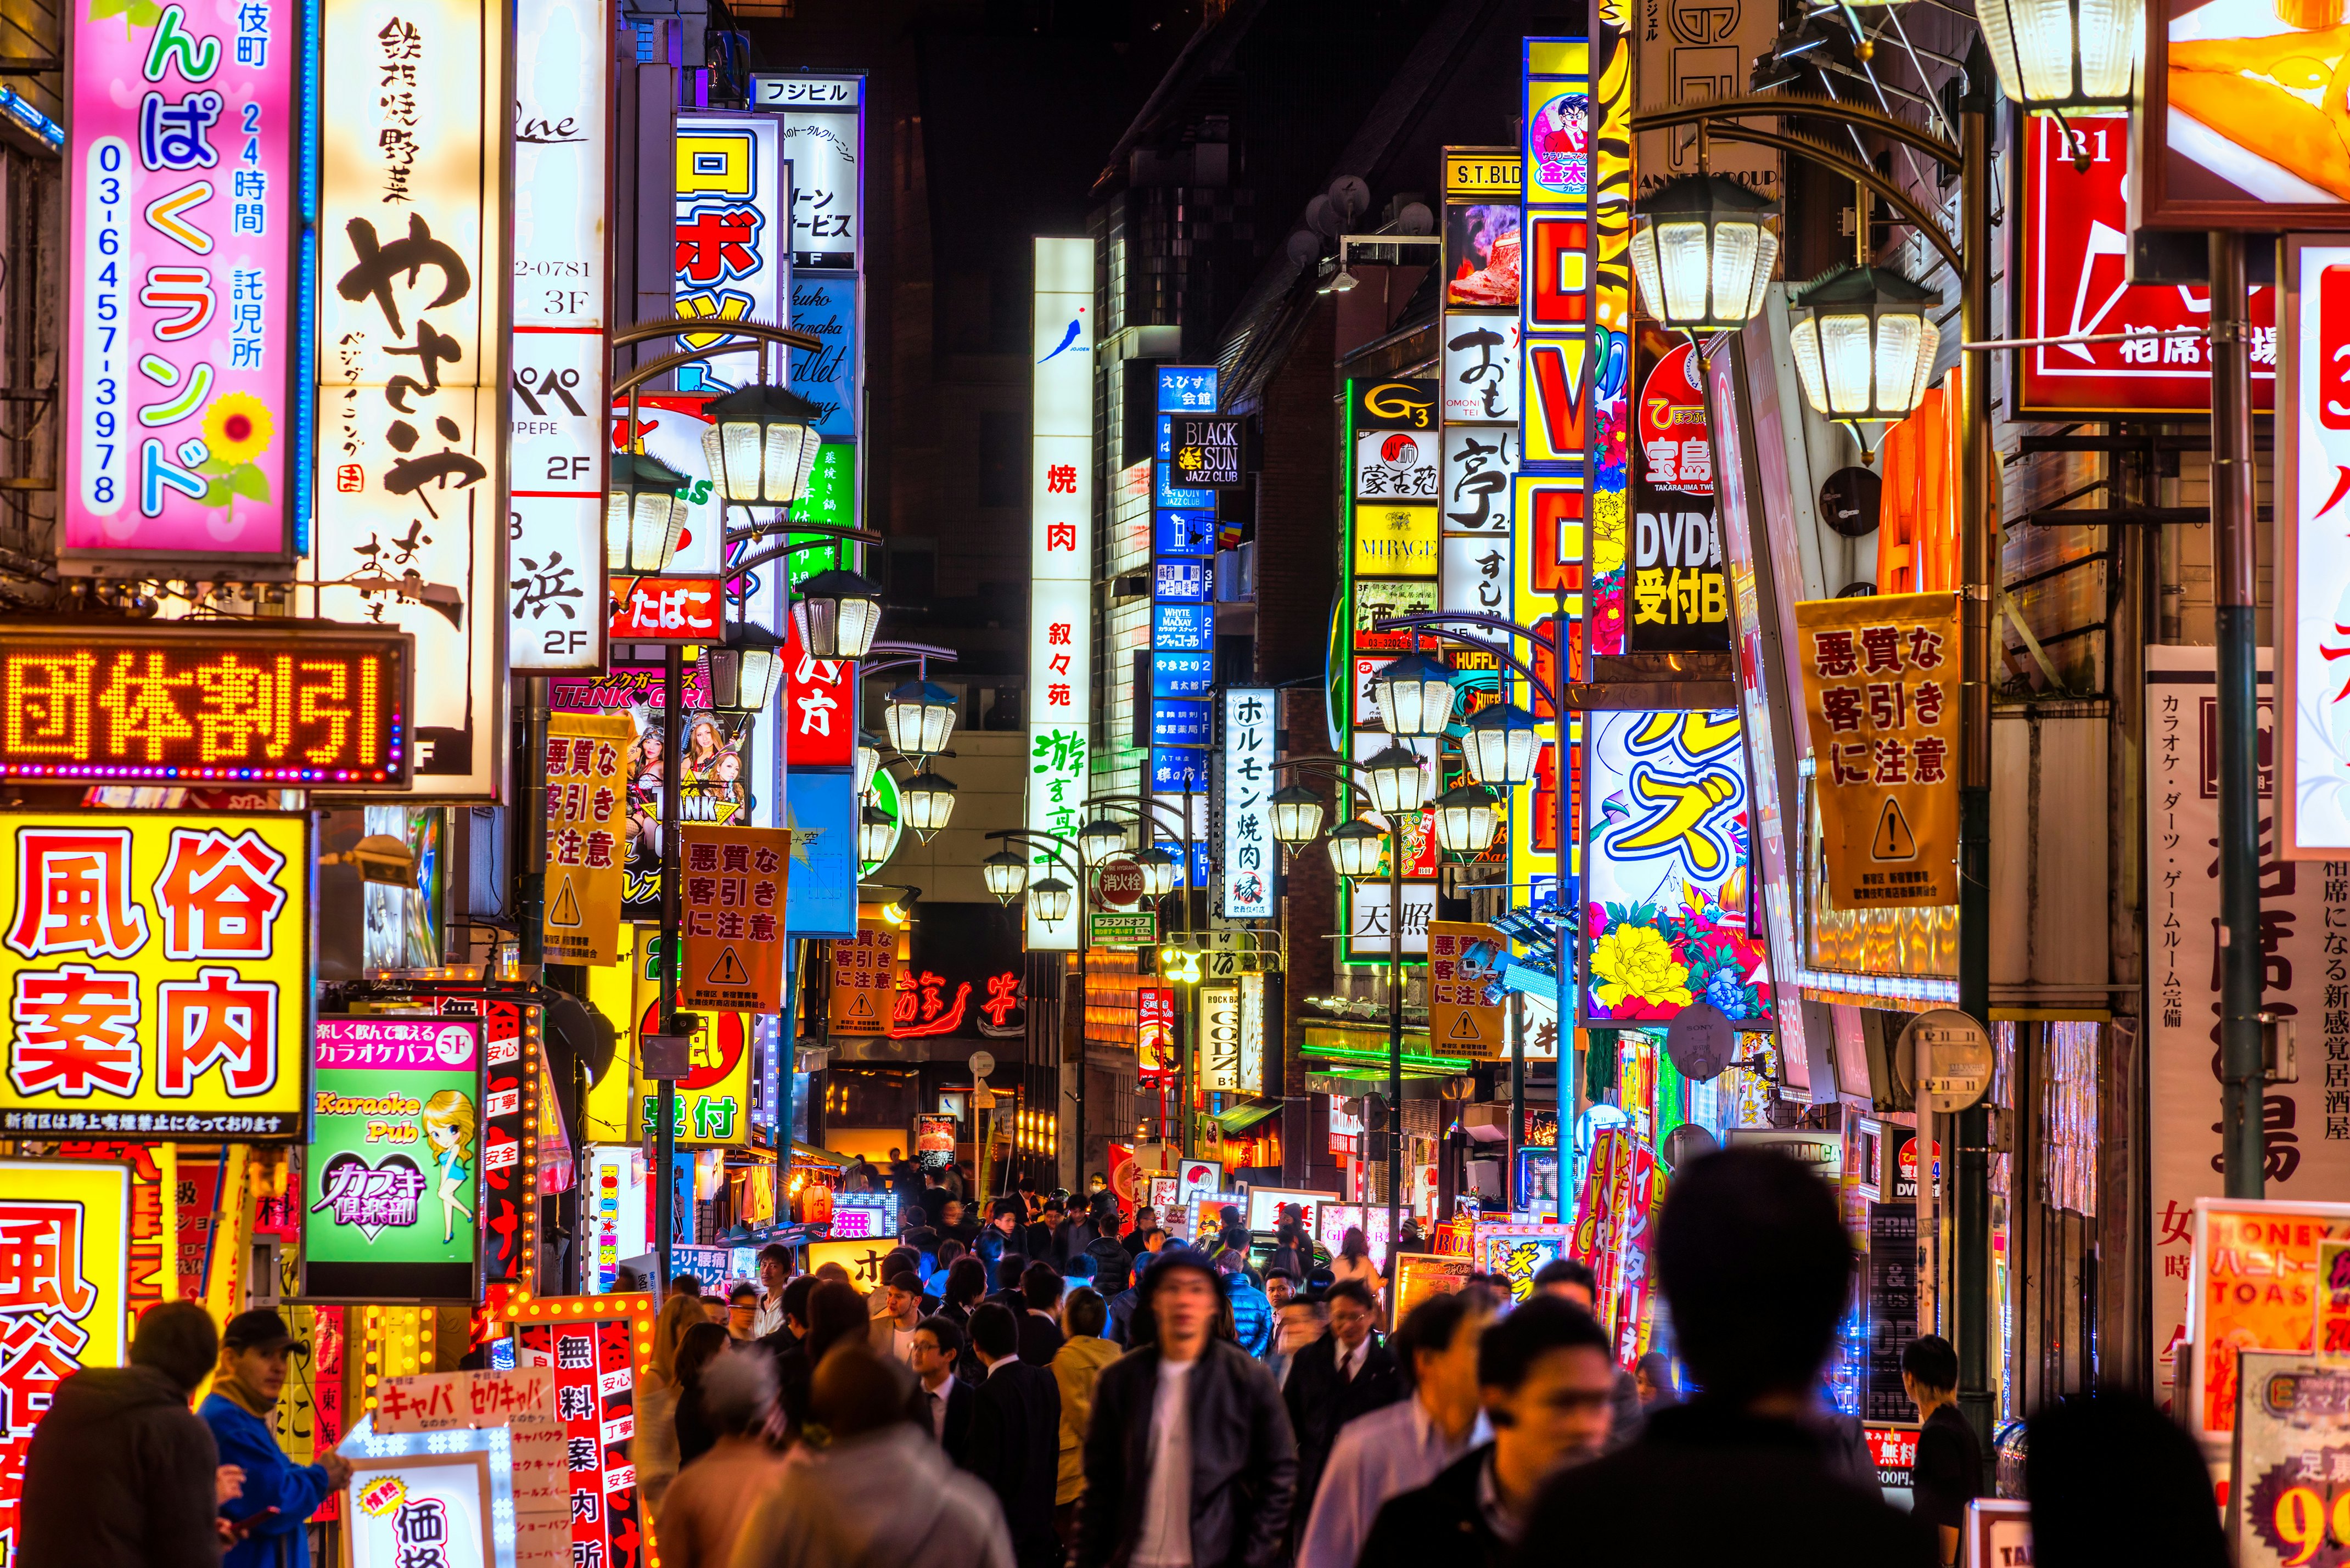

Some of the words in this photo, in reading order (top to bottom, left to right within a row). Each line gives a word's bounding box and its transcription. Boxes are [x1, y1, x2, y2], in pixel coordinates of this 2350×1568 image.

[236, 0, 270, 66] 伎町
[767, 82, 848, 102] フジビル
[378, 16, 423, 204] 鉄板焼野菜
[234, 104, 267, 234] 24時間
[141, 4, 223, 518] んぱくランド
[515, 261, 591, 278] 2-0781
[543, 290, 590, 315] 3F
[94, 145, 121, 504] 03-6457-3978
[228, 269, 266, 370] 託児所
[2119, 324, 2277, 365] 相席場
[336, 212, 487, 520] やさいや
[1160, 374, 1204, 389] えびす
[1181, 391, 1211, 406] 会館
[1185, 422, 1238, 446] BLACK
[547, 456, 591, 480] 2F
[1204, 446, 1238, 470] SUN
[1185, 470, 1210, 482] JAZZ
[1212, 470, 1238, 482] CLUB
[1359, 464, 1438, 496] 蒙古苑
[1047, 464, 1077, 552] 焼肉
[1165, 497, 1182, 505] JAZZ
[1183, 497, 1200, 505] CLUB
[1205, 522, 1213, 544] 3F
[1360, 539, 1437, 557] MIRAGE
[1158, 566, 1175, 580] 麻雀
[1204, 569, 1213, 592] 3F
[511, 550, 584, 621] 浜
[1372, 583, 1414, 591] 個室タイプ
[631, 589, 713, 628] たばこ
[1164, 608, 1191, 617] WHYTE
[1162, 617, 1192, 626] MACKAY
[1204, 617, 1212, 639] 2F
[544, 630, 588, 654] 2F
[1813, 625, 1945, 679] 悪質な
[1048, 622, 1072, 706] 叙々苑
[1156, 660, 1200, 671] やきとり
[588, 672, 698, 689] タンクガーズ
[4, 652, 381, 765] 団体割引
[554, 686, 633, 708] TANK
[1820, 681, 1944, 734] 客引き
[1155, 711, 1198, 719] 保険調剤
[1155, 724, 1198, 734] 梅屋薬局
[547, 738, 618, 779] 悪質な
[1829, 735, 1949, 788] に注意
[1236, 696, 1263, 870] ホルモン焼肉
[689, 843, 780, 875] 悪質な
[1414, 835, 1426, 859] パブ
[2161, 694, 2183, 1029] カラオケ・ダーツ・ゲームルーム完備
[7, 828, 285, 958] 風俗
[687, 877, 778, 908] 客引き
[1103, 873, 1142, 892] 消火栓
[1233, 905, 1266, 914] 歌舞伎町店
[1356, 902, 1433, 936] 天照
[687, 910, 777, 943] に注意
[835, 949, 892, 969] 客引き
[835, 969, 892, 990] に注意
[687, 998, 766, 1010] 歌舞伎町商店街振興組合
[695, 990, 717, 998] 新宿区
[722, 990, 759, 1000] 新宿警察署
[9, 966, 280, 1097] 案内
[316, 1023, 436, 1042] 楽しく飲んで歌える
[1210, 1011, 1237, 1071] GODZ
[316, 1043, 435, 1064] カラオケパブ
[439, 1033, 470, 1055] 5F
[487, 1042, 518, 1062] 安心
[1218, 1077, 1234, 1086] B1
[314, 1091, 421, 1116] Karaoke
[487, 1092, 517, 1114] 丁寧
[4, 1113, 282, 1133] 新宿区は路上喫煙禁止になっております
[366, 1120, 419, 1144] Pub
[485, 1146, 517, 1168] 安全
[312, 1161, 427, 1213] カブキ
[599, 1164, 620, 1221] ROBOT
[334, 1196, 418, 1227] 倶楽部
[1452, 1228, 1474, 1236] Welcom
[602, 1372, 631, 1392] 安心
[382, 1382, 455, 1421] キャバ
[470, 1376, 542, 1415] セクキャバ
[513, 1430, 563, 1443] キャバクラ
[603, 1420, 633, 1440] 丁寧
[556, 1334, 603, 1568] 無料案内所
[1879, 1442, 1916, 1466] 無料
[607, 1469, 637, 1488] 安全
